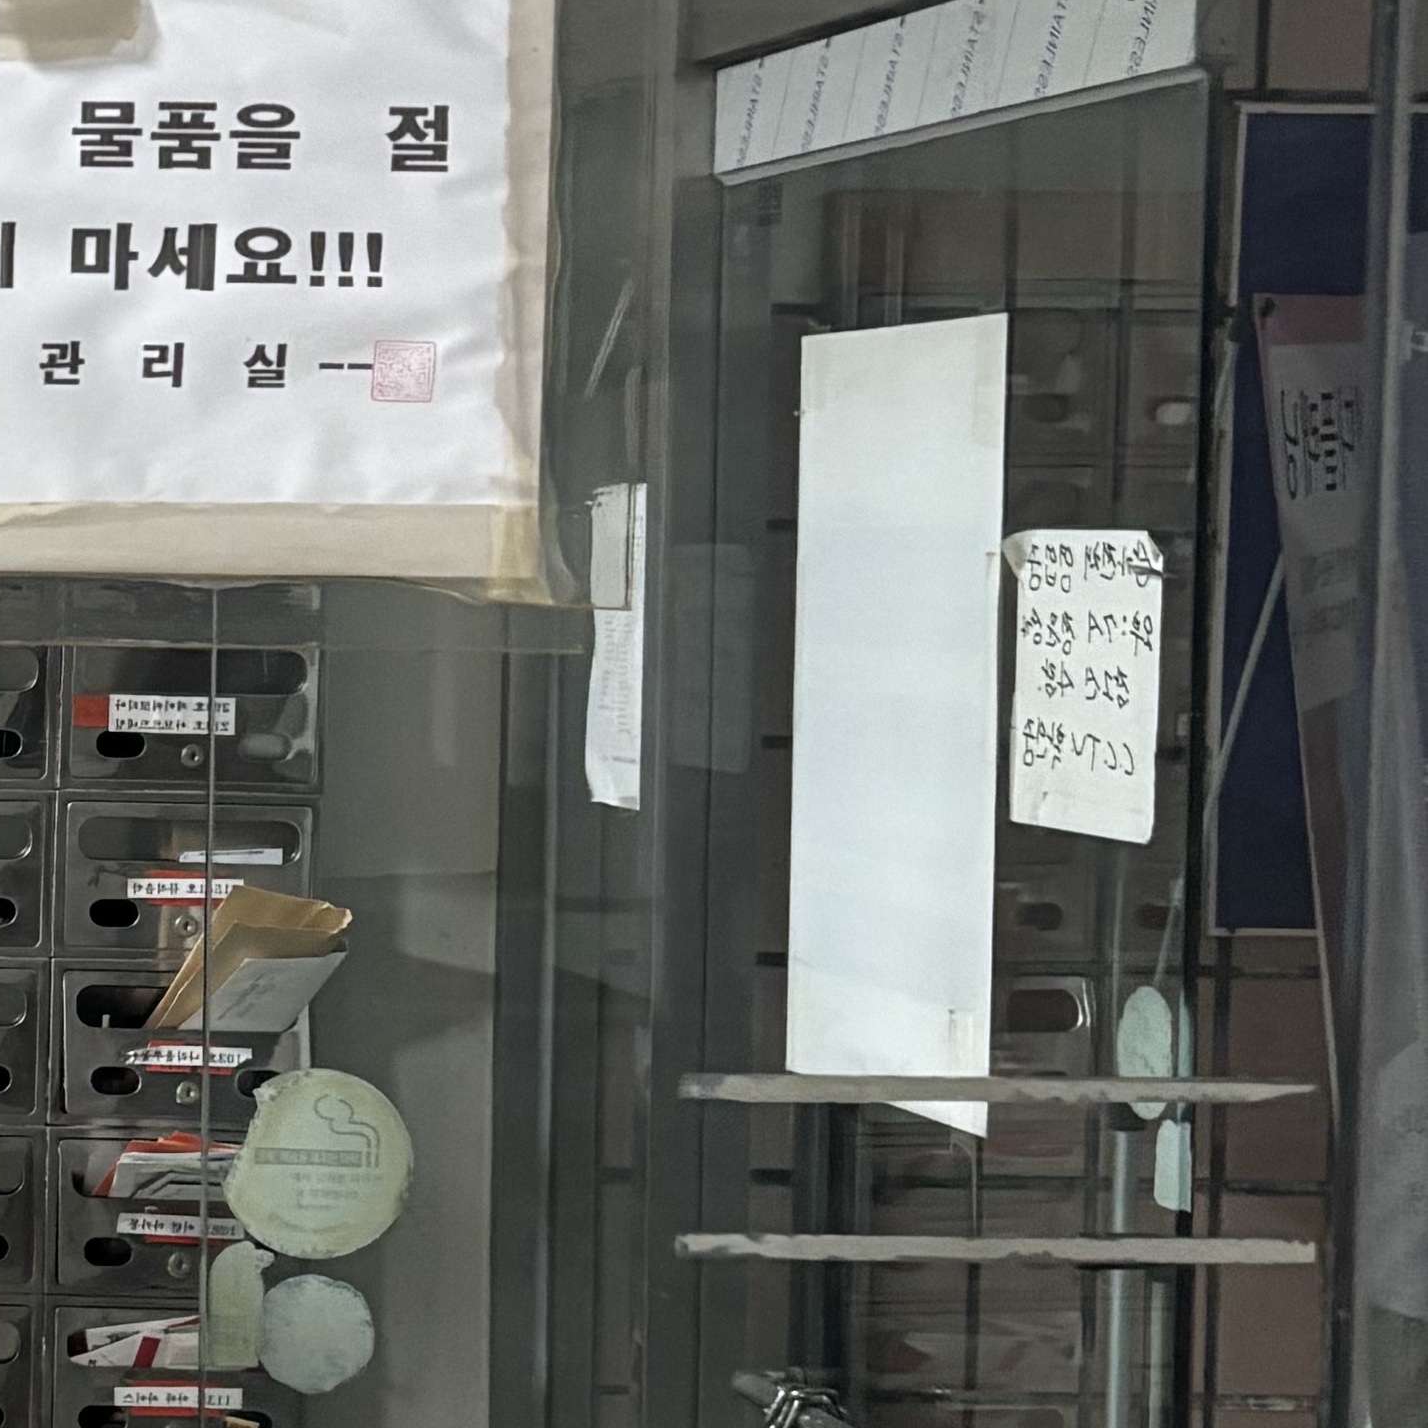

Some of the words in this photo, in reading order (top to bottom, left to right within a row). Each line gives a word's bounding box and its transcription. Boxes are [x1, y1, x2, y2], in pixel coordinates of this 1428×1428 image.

[72, 101, 301, 170] 물품을
[386, 105, 450, 172] 절
[71, 222, 384, 292] 마세요!!!
